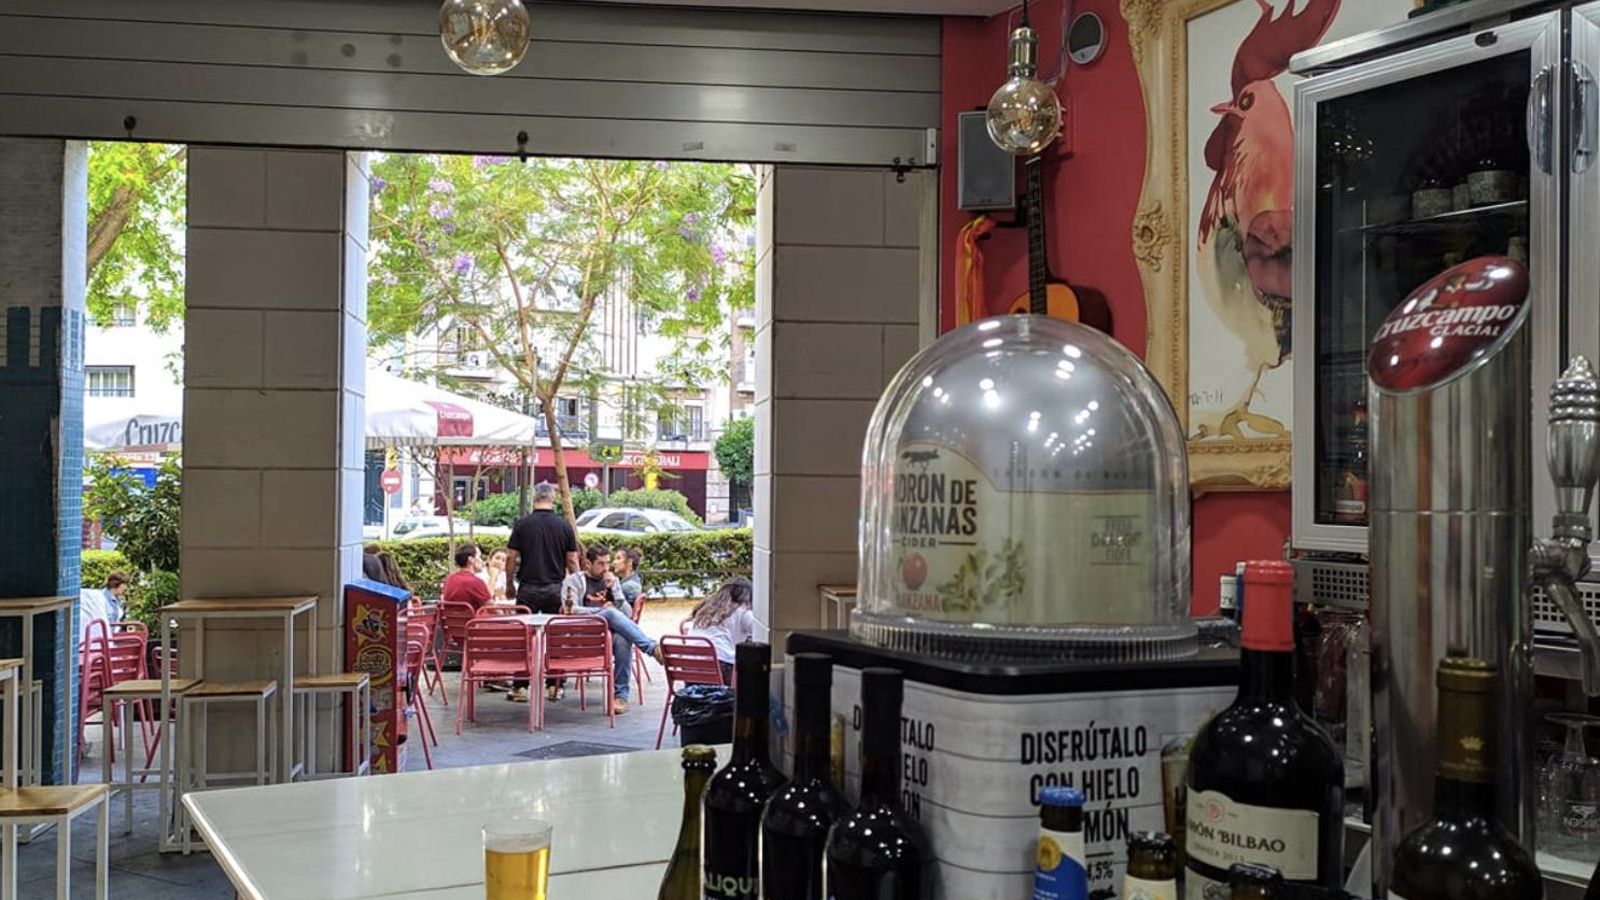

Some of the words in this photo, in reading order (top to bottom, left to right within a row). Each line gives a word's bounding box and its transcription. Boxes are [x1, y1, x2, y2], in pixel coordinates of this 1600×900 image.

[1429, 325, 1500, 337] GLACIAL
[951, 480, 977, 505] DE
[901, 537, 937, 548] CIDER
[1021, 720, 1147, 765] DISFRÚTALO
[1082, 766, 1139, 801] HIELO
[1084, 801, 1130, 844] MÓN
